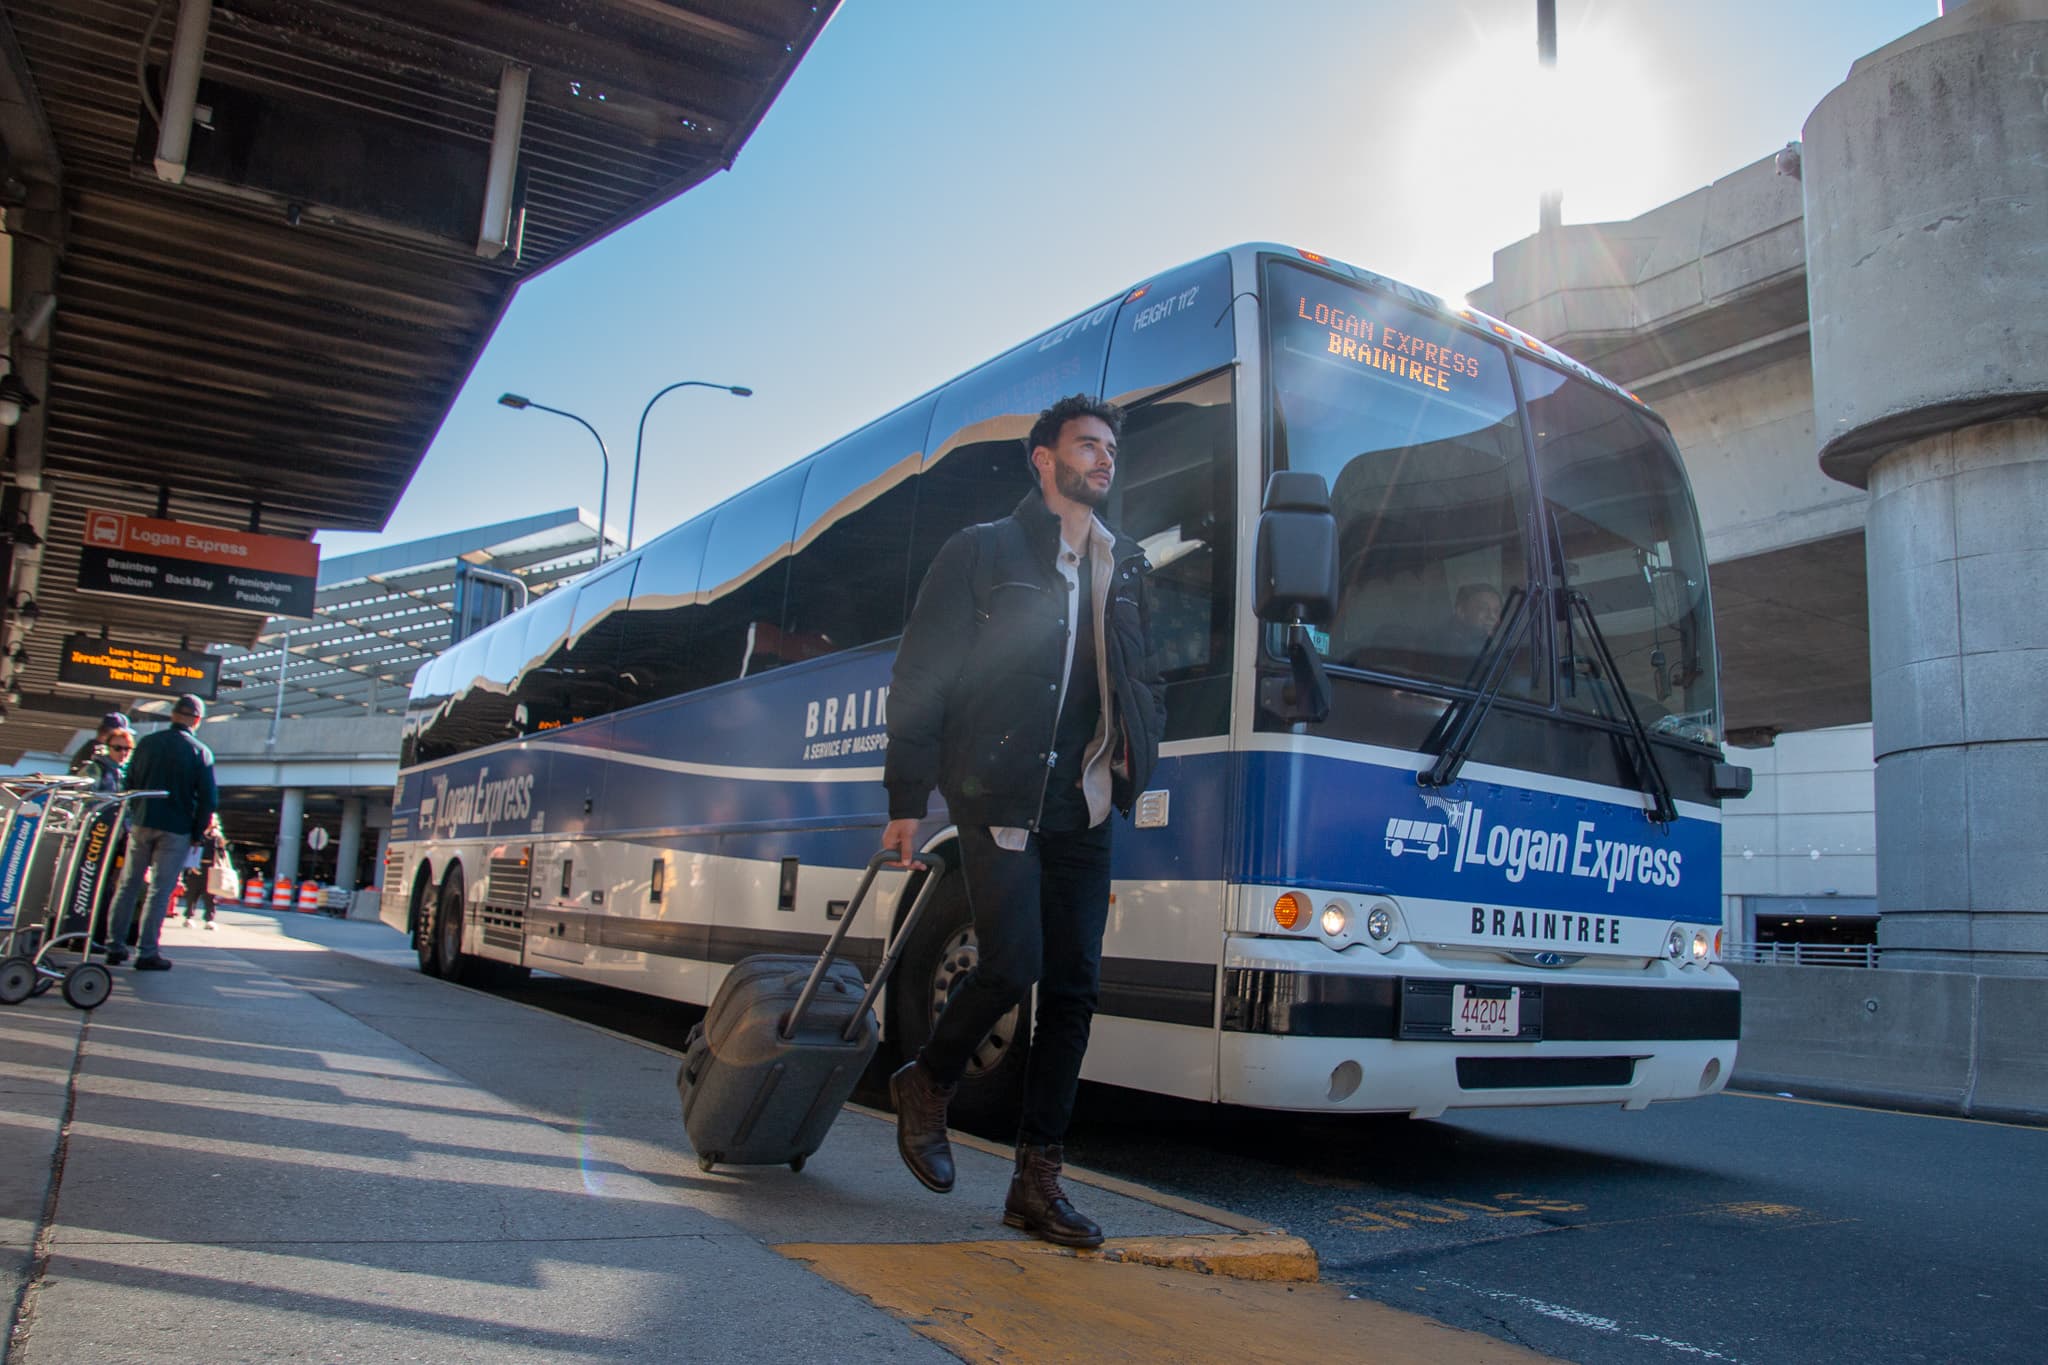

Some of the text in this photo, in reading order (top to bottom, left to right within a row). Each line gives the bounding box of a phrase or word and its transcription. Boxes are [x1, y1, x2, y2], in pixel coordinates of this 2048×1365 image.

[1133, 296, 1177, 332] HEIGHT
[1298, 297, 1480, 378] LOGAN EXPRESS
[1327, 332, 1451, 392] BRAINTREE
[131, 527, 248, 556] Logan Express
[107, 558, 158, 574] Braintree
[110, 573, 153, 588] Woburn
[228, 575, 292, 593] Framingham
[236, 590, 280, 607] Peabody
[110, 668, 154, 684] Terminal
[803, 744, 810, 760] A
[810, 739, 841, 760] SERVICE
[841, 738, 853, 755] OF
[438, 767, 534, 839] Logan Express
[1465, 808, 1682, 893] Logan Express
[1471, 906, 1620, 944] BRAINTREE
[1461, 999, 1507, 1024] 44204
